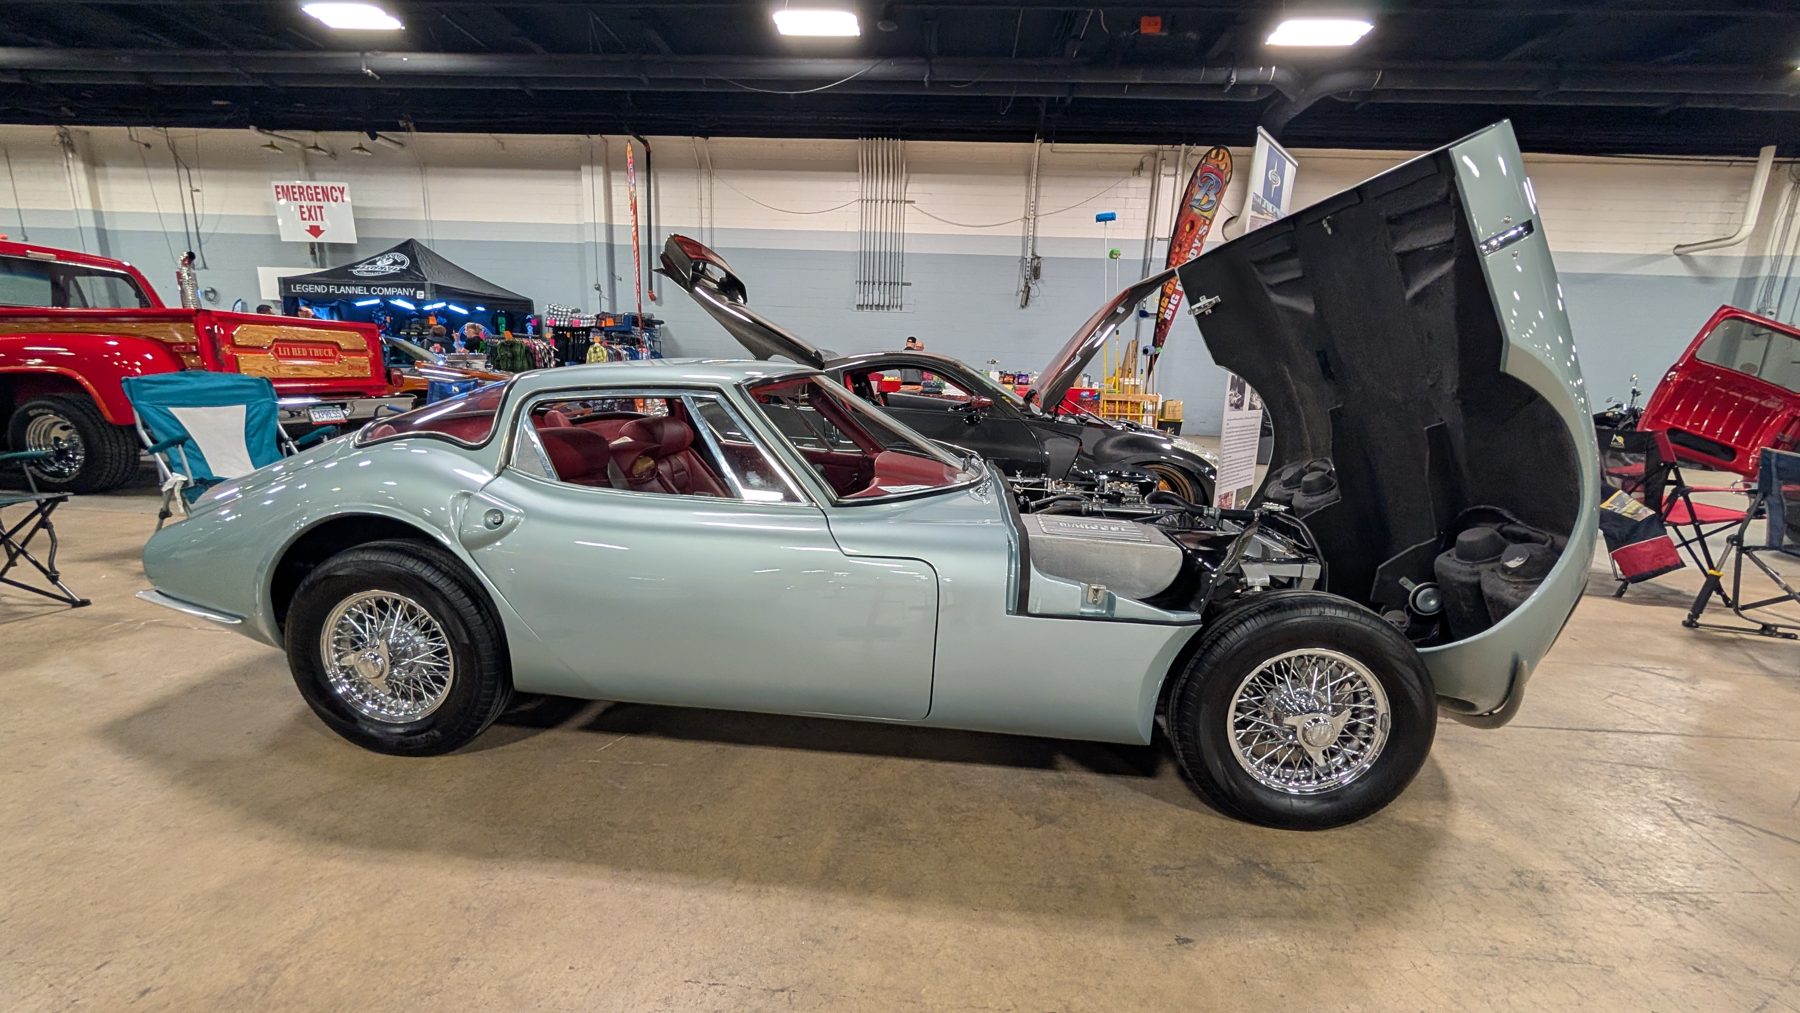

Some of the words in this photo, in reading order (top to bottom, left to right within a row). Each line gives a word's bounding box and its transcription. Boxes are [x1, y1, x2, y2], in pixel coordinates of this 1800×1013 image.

[274, 185, 345, 203] EMERGENCY
[299, 205, 324, 222] EXIT
[291, 284, 328, 293] LEGEND
[329, 285, 370, 295] FLANNEL
[370, 287, 415, 296] COMPANY
[1164, 293, 1180, 320] BIG
[291, 347, 308, 356] RED
[307, 348, 334, 357] TRUCK
[311, 409, 342, 419] EXPRESS
